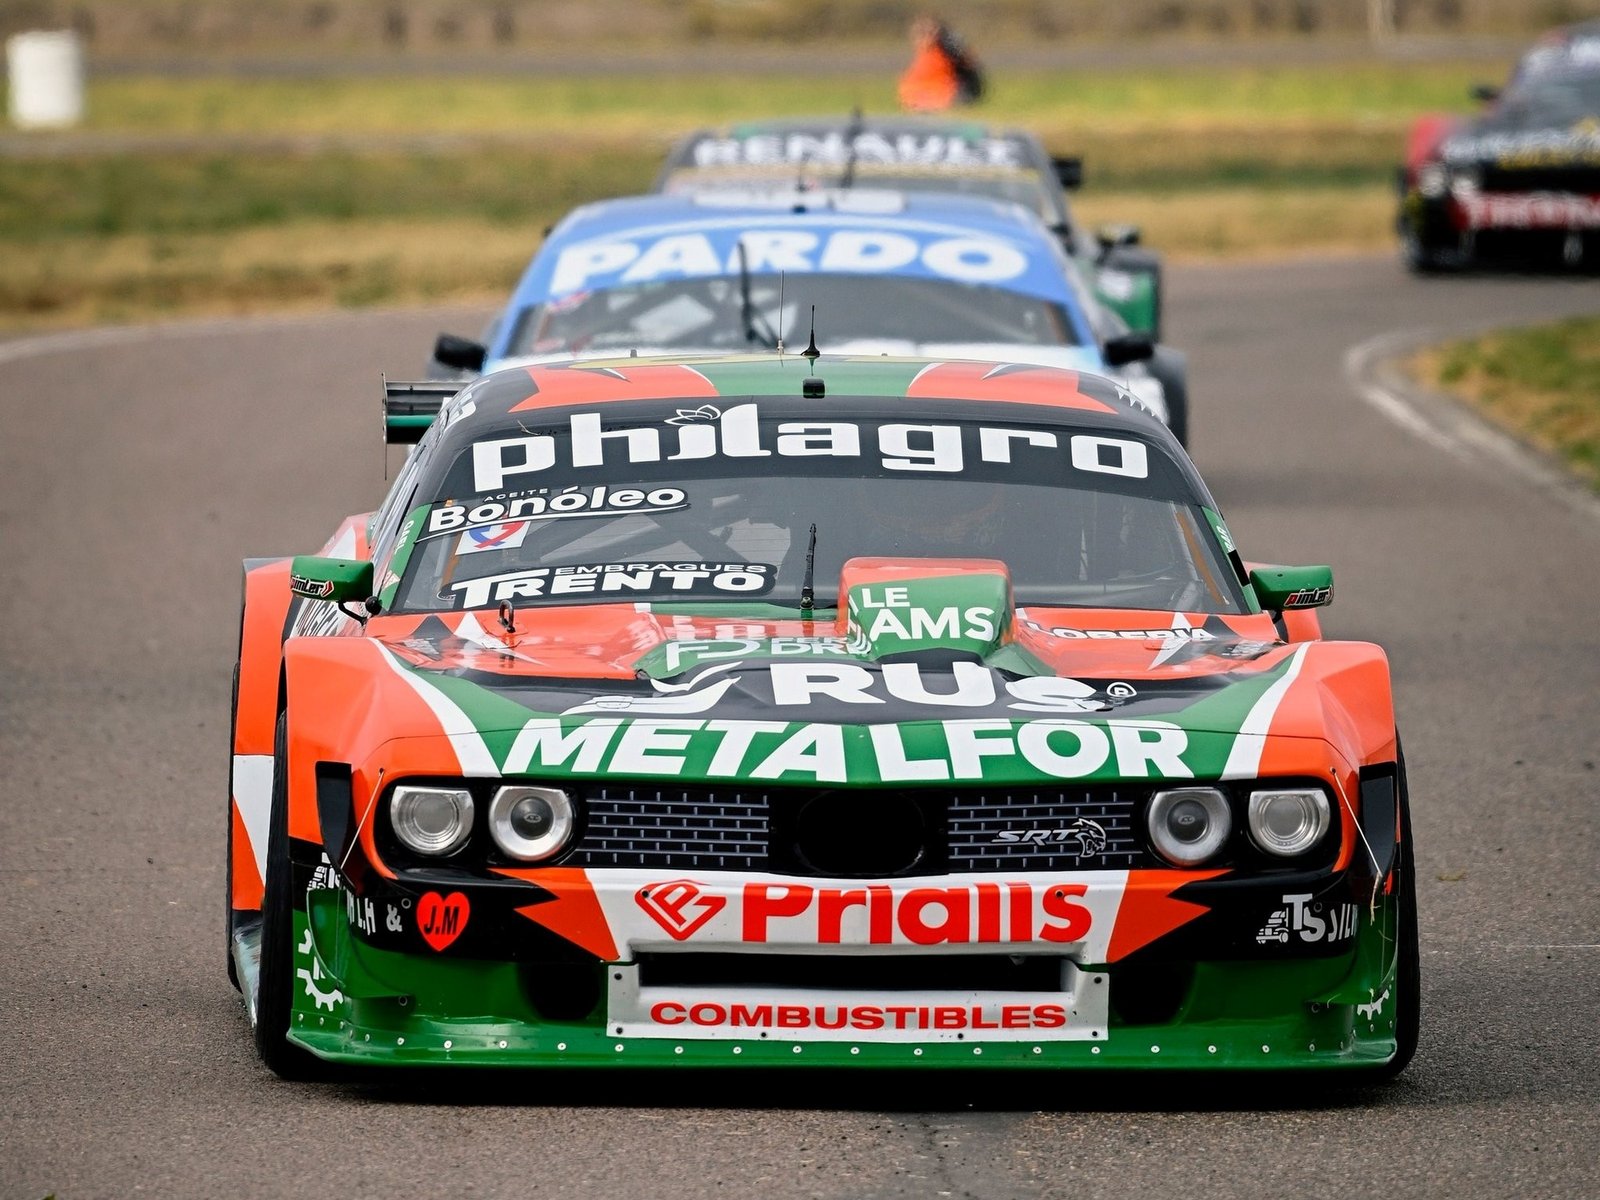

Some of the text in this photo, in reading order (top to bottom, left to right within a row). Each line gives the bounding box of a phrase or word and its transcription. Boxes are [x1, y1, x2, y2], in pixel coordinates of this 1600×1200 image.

[548, 229, 1029, 295] PARDO
[473, 403, 1149, 492] philagro
[428, 486, 686, 532] Bonóleo
[484, 488, 548, 502] ACEITE
[450, 568, 766, 609] TRENTO
[555, 563, 768, 575] EMBRAGUES
[502, 719, 1194, 783] METALFOR
[990, 828, 1080, 847] SRT
[386, 903, 403, 933] &
[424, 905, 460, 936] J.M
[742, 882, 1093, 946] Prialis
[649, 1002, 1067, 1030] COMBUSTIBLES
